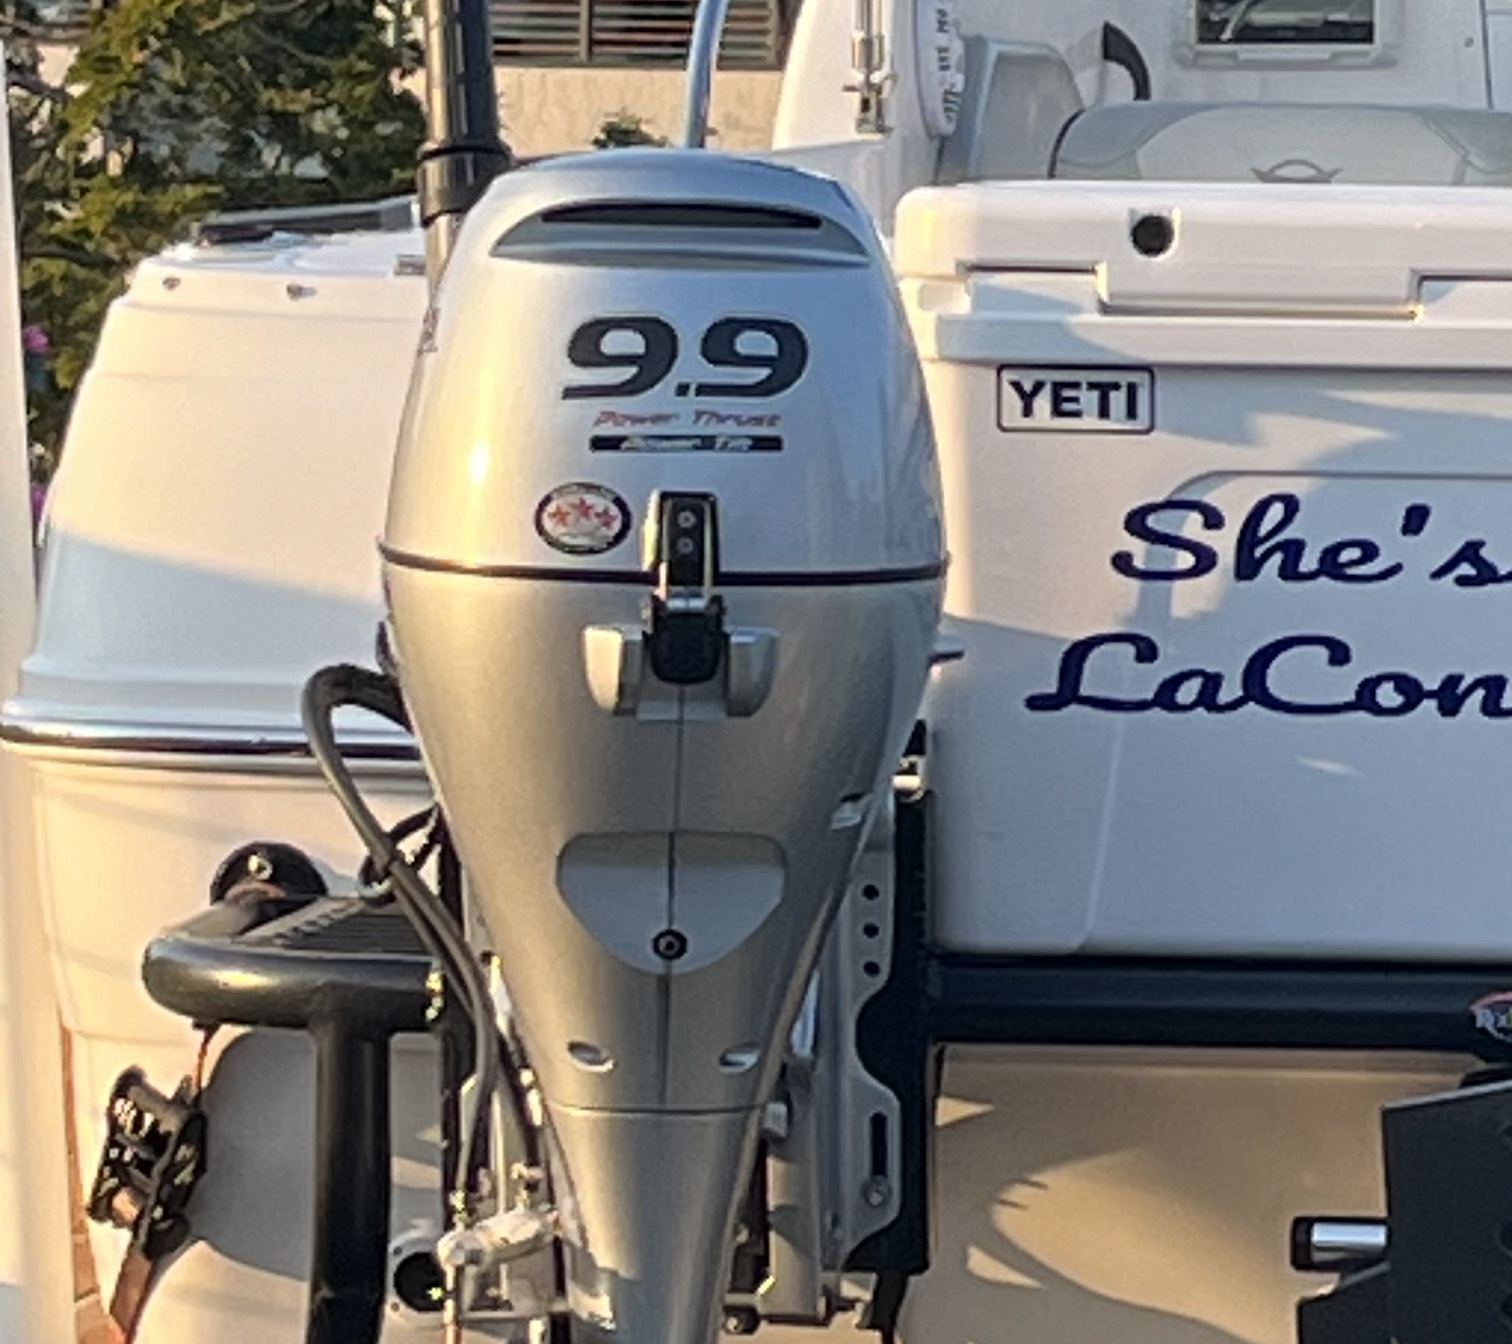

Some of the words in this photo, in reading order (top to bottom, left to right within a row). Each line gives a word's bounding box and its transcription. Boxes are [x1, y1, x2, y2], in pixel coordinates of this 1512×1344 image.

[560, 314, 810, 401] 9.9
[692, 409, 783, 427] Thrust
[1008, 378, 1140, 422] YETI
